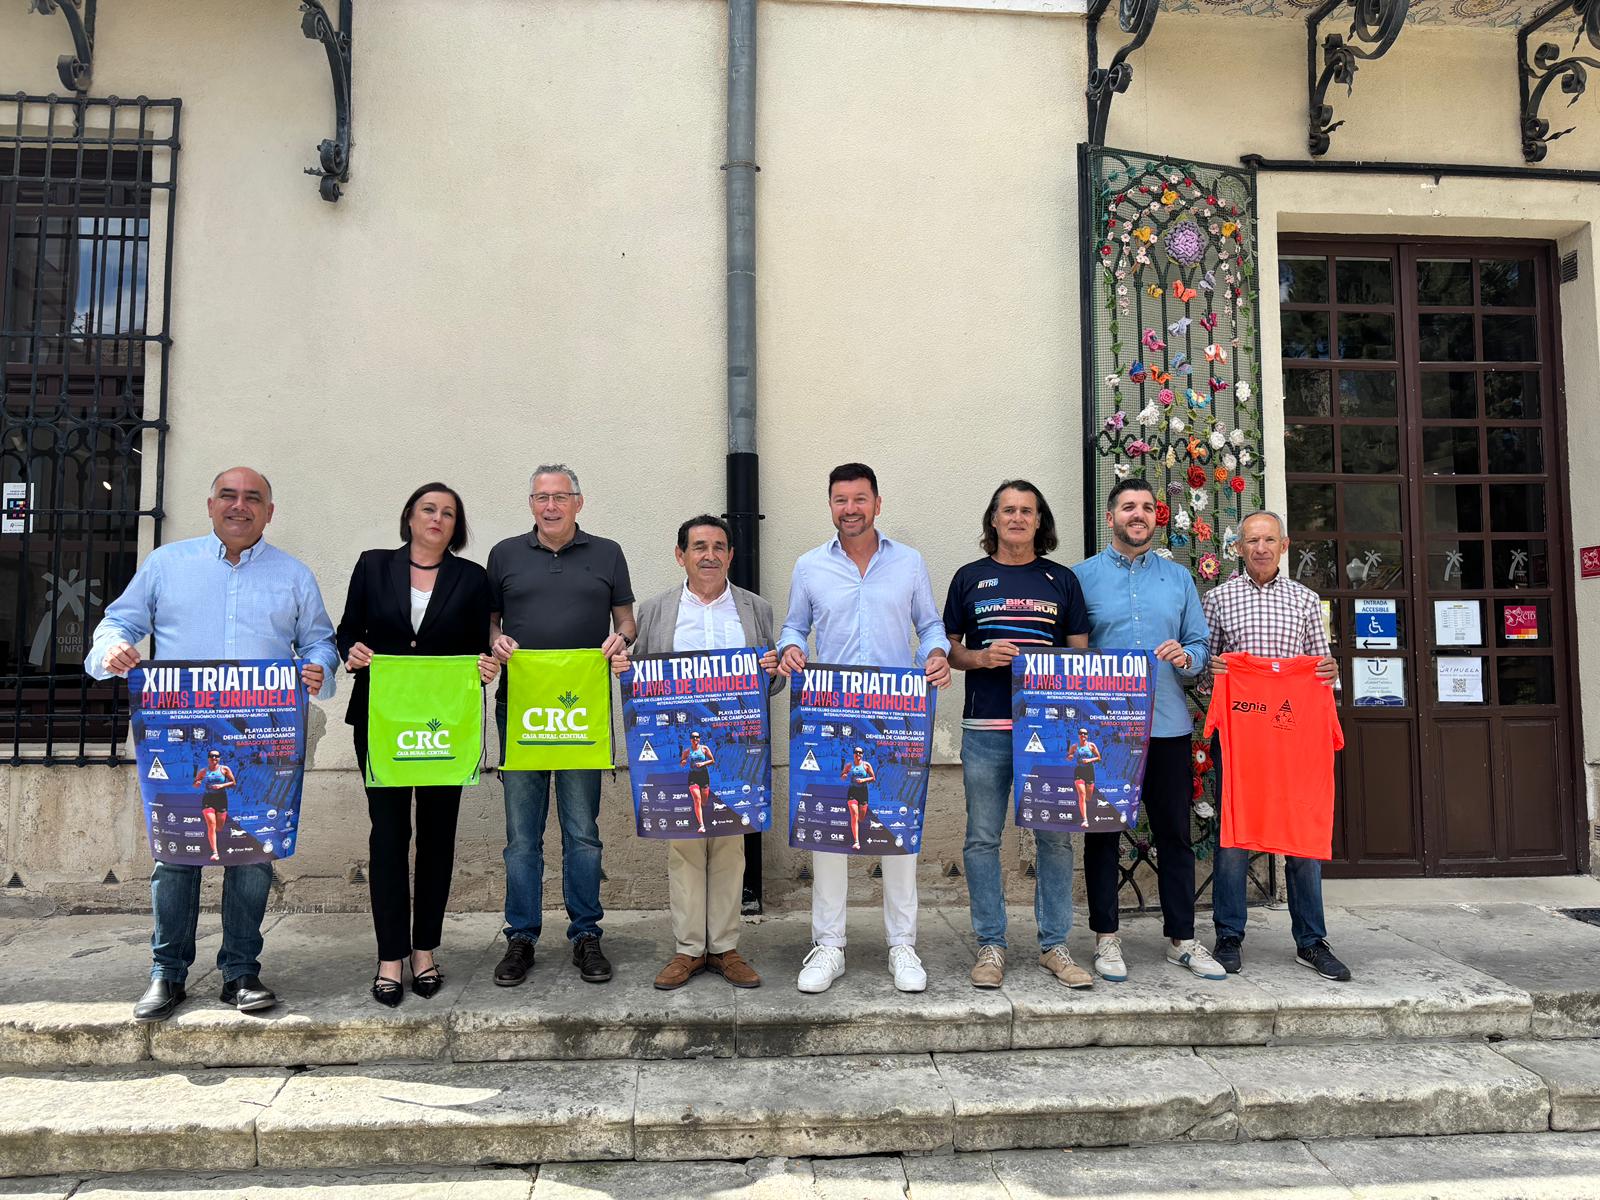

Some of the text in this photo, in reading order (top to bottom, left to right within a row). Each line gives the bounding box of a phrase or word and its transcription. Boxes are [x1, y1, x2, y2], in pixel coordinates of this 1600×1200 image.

[975, 604, 1007, 615] SWIM
[1034, 605, 1057, 615] RUN
[632, 651, 758, 682] XIII TRIATLÓN
[1024, 652, 1147, 677] XIII TRIATLÓN
[142, 663, 295, 692] XIII TRIATLÓN
[633, 674, 759, 697] PLAYAS DE ORIHUELA
[802, 669, 926, 696] XIII TRIATLÓN
[1024, 674, 1147, 692] PLAYAS DE ORIHUELA
[142, 690, 296, 708] PLAYAS DE ORIHUELA
[801, 690, 926, 711] PLAYAS DE ORIHUELA
[522, 707, 589, 732] CRC
[397, 730, 450, 750] CRC
